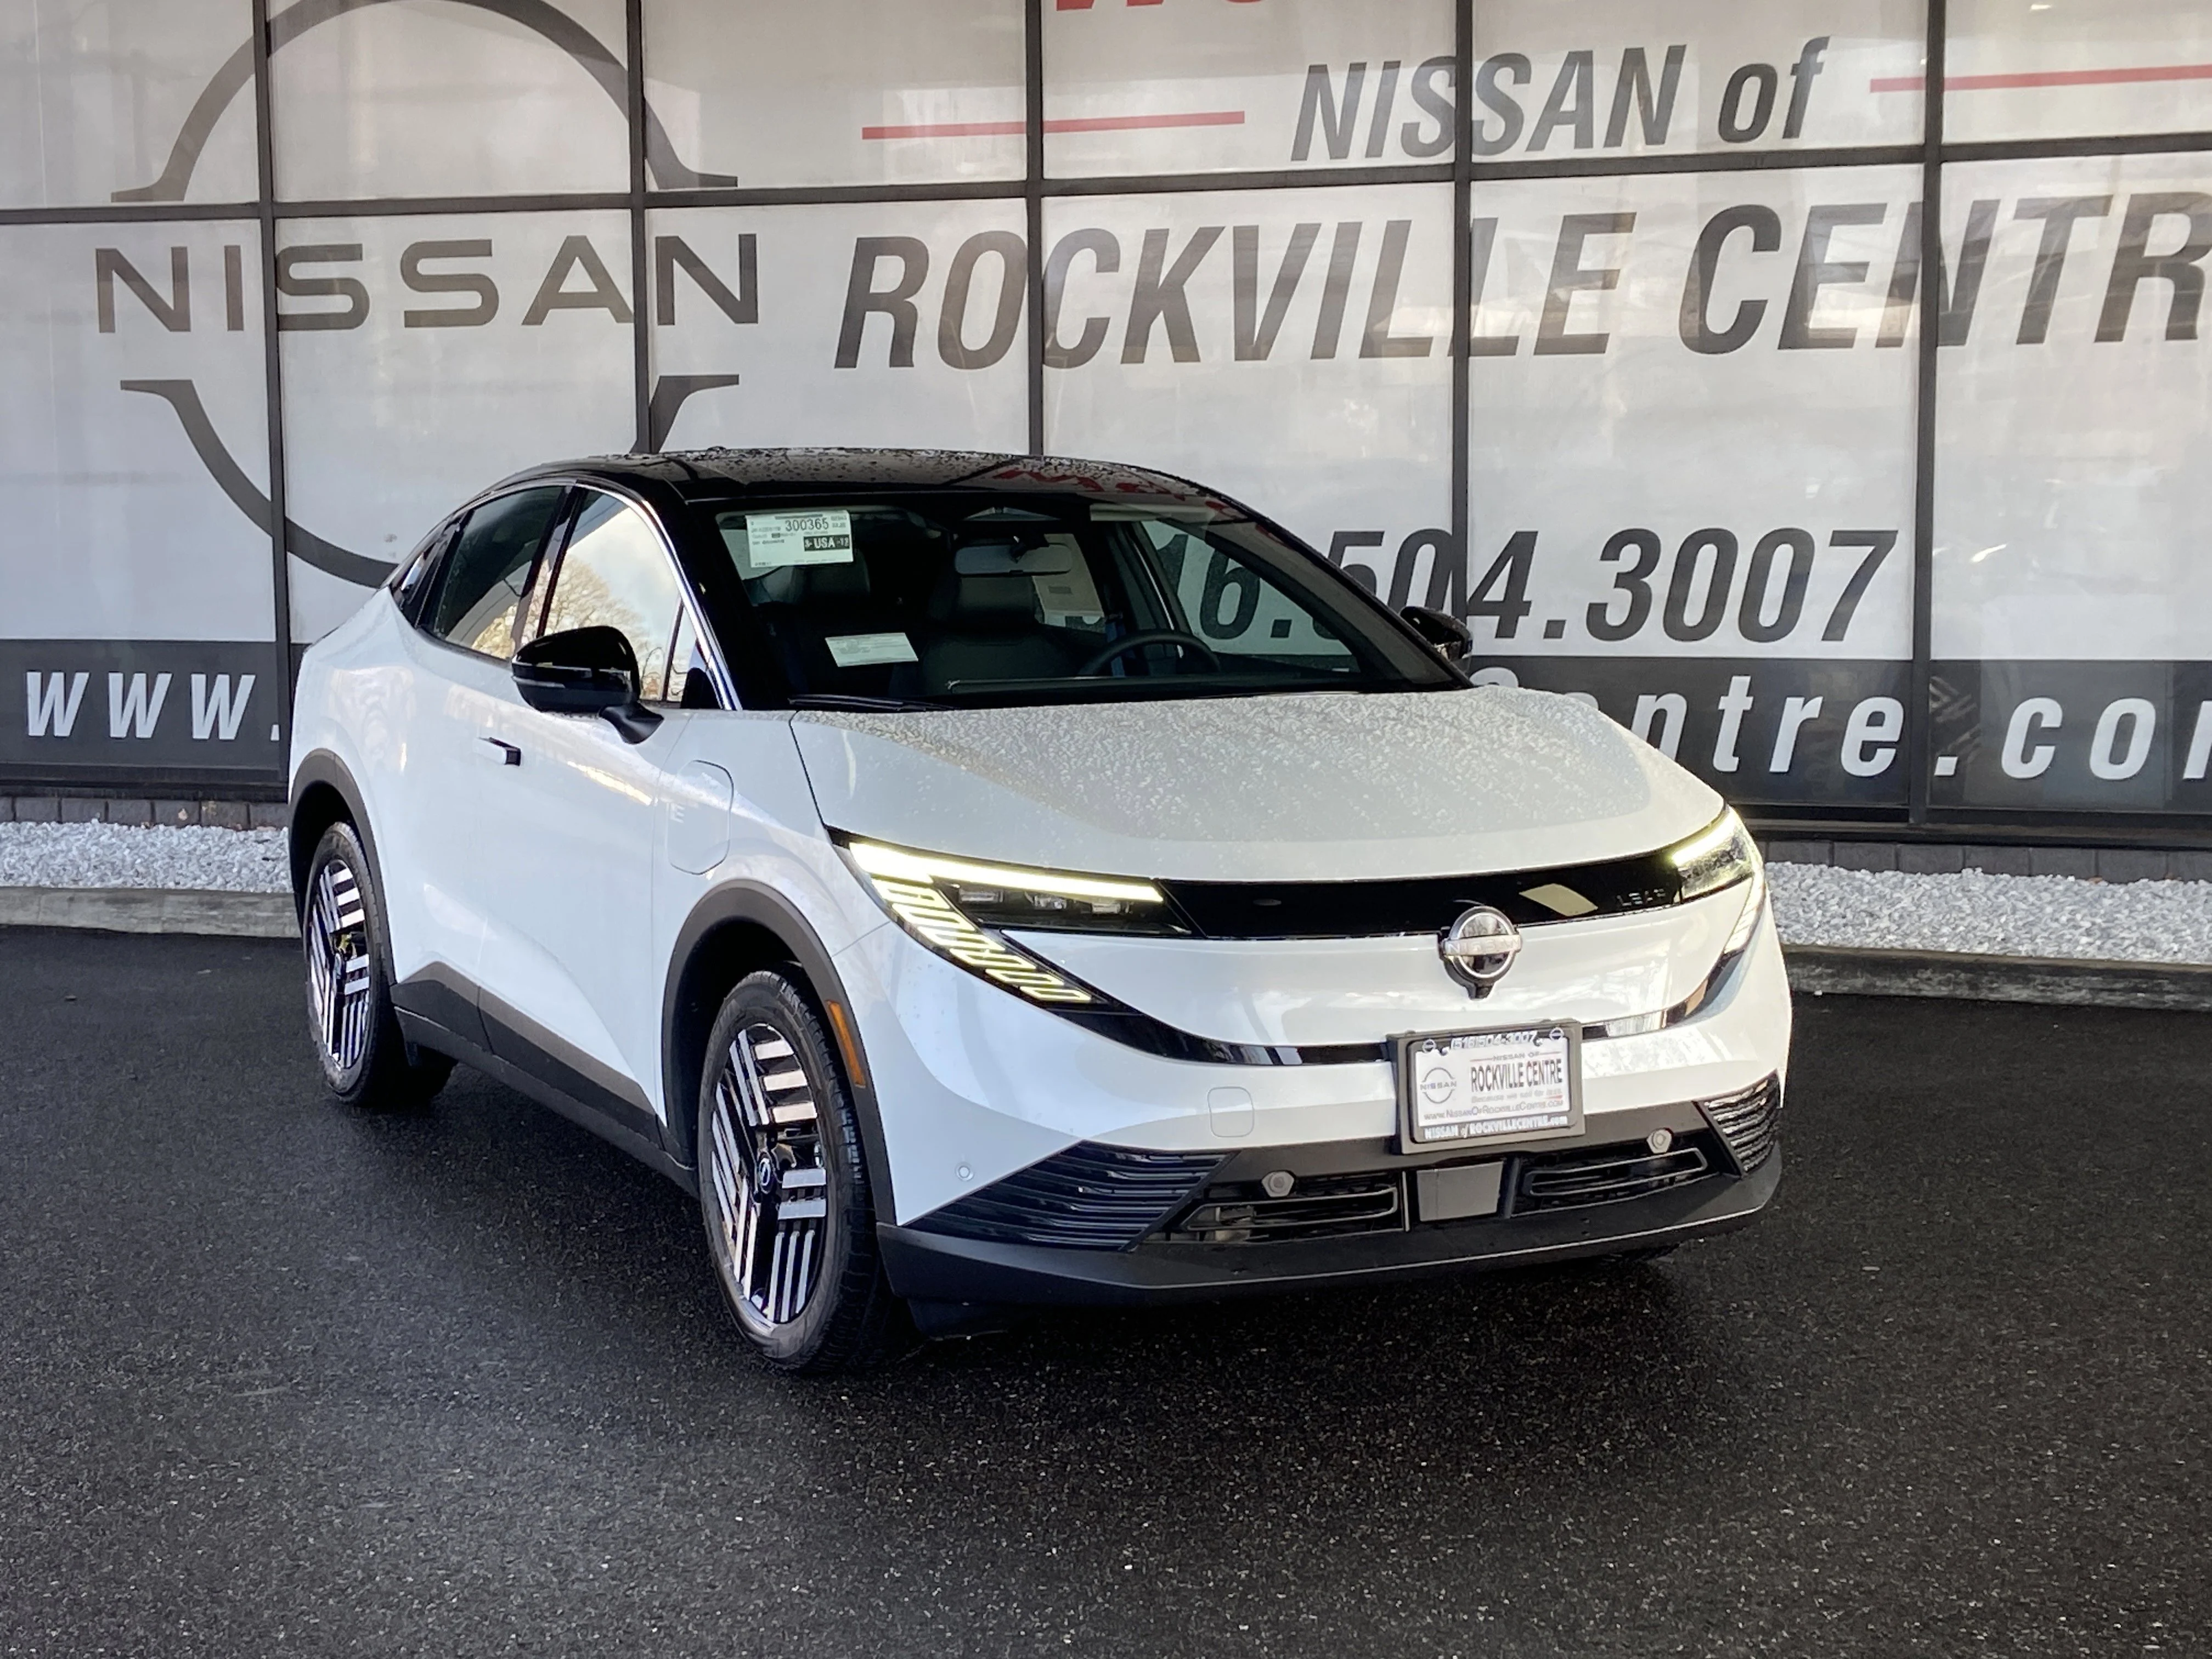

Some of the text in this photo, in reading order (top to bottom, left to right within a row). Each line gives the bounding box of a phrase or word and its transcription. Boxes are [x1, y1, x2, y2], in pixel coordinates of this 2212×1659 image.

[1290, 36, 1830, 161] NISSAN of
[95, 233, 759, 334] NISSAN
[833, 211, 1638, 370] ROCKVILLE
[785, 517, 829, 532] 300365
[813, 537, 836, 549] USA
[1445, 936, 1519, 955] NISSAN
[1420, 1081, 1457, 1091] NISSAN
[1471, 1058, 1563, 1092] ROCKVILLE CENTRE
